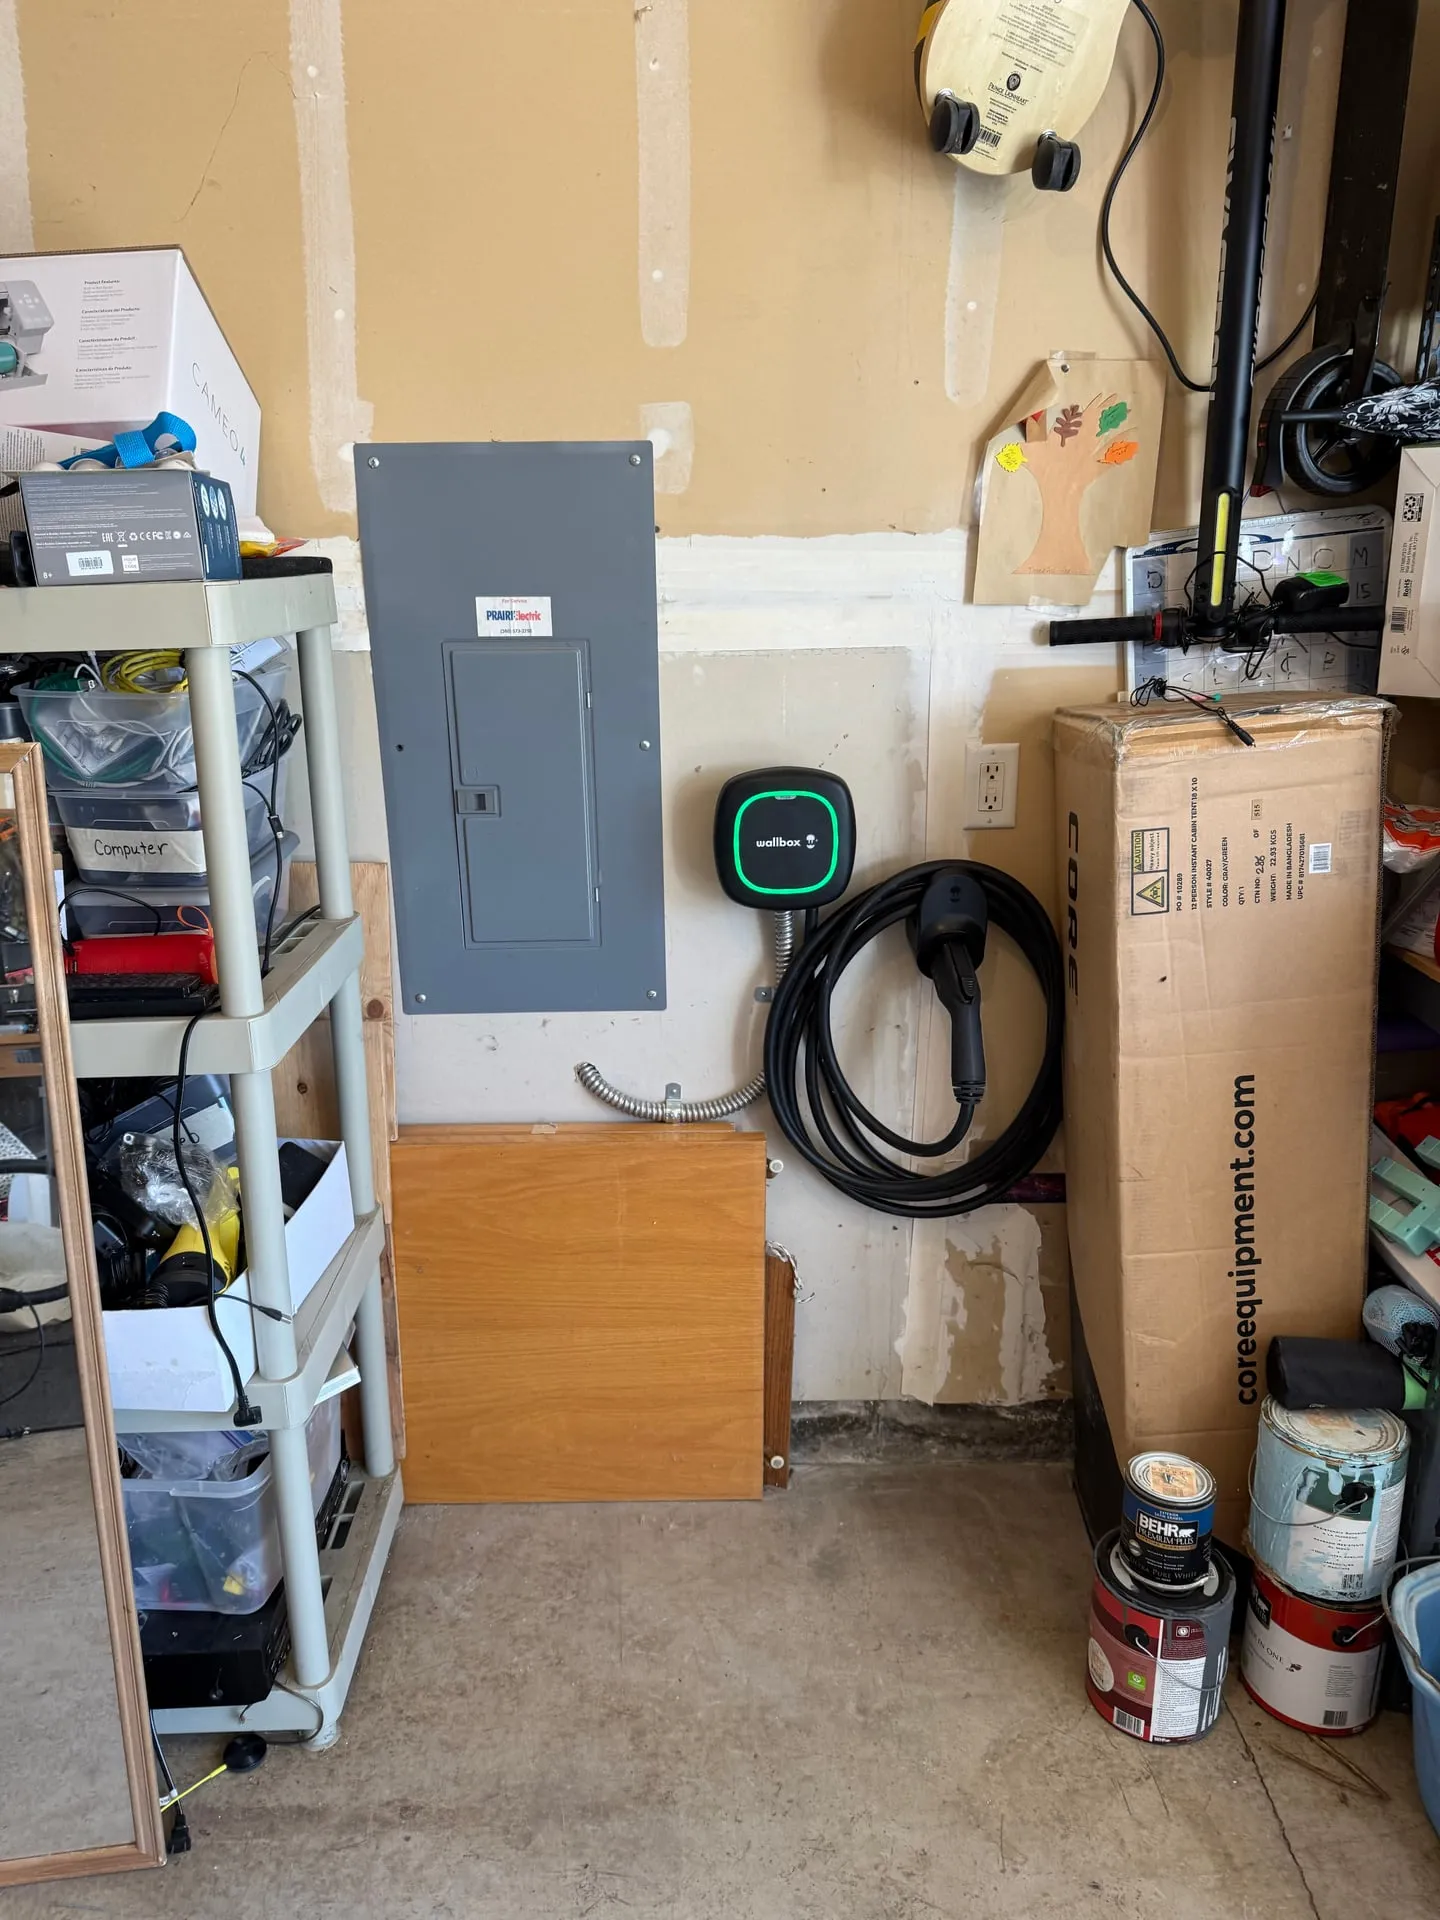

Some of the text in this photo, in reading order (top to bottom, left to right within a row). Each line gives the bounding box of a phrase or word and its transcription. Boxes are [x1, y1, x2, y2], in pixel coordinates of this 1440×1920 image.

[192, 362, 239, 452] CAMEO
[1192, 777, 1198, 785] 10
[1253, 829, 1260, 838] OF
[94, 839, 168, 860] Computer
[756, 836, 801, 848] wallbox
[1286, 871, 1292, 879] IN
[1068, 811, 1079, 997] CORE
[1176, 902, 1182, 912] PO
[1191, 902, 1197, 911] 12
[1230, 1073, 1262, 1406] coreequipment.com
[1139, 1513, 1179, 1538] BEHR
[1138, 1527, 1174, 1545] PREMIUM
[1175, 1536, 1194, 1545] PLUS
[1152, 1568, 1171, 1579] PURE
[1257, 1638, 1265, 1649] IN
[1266, 1647, 1283, 1664] ONE
